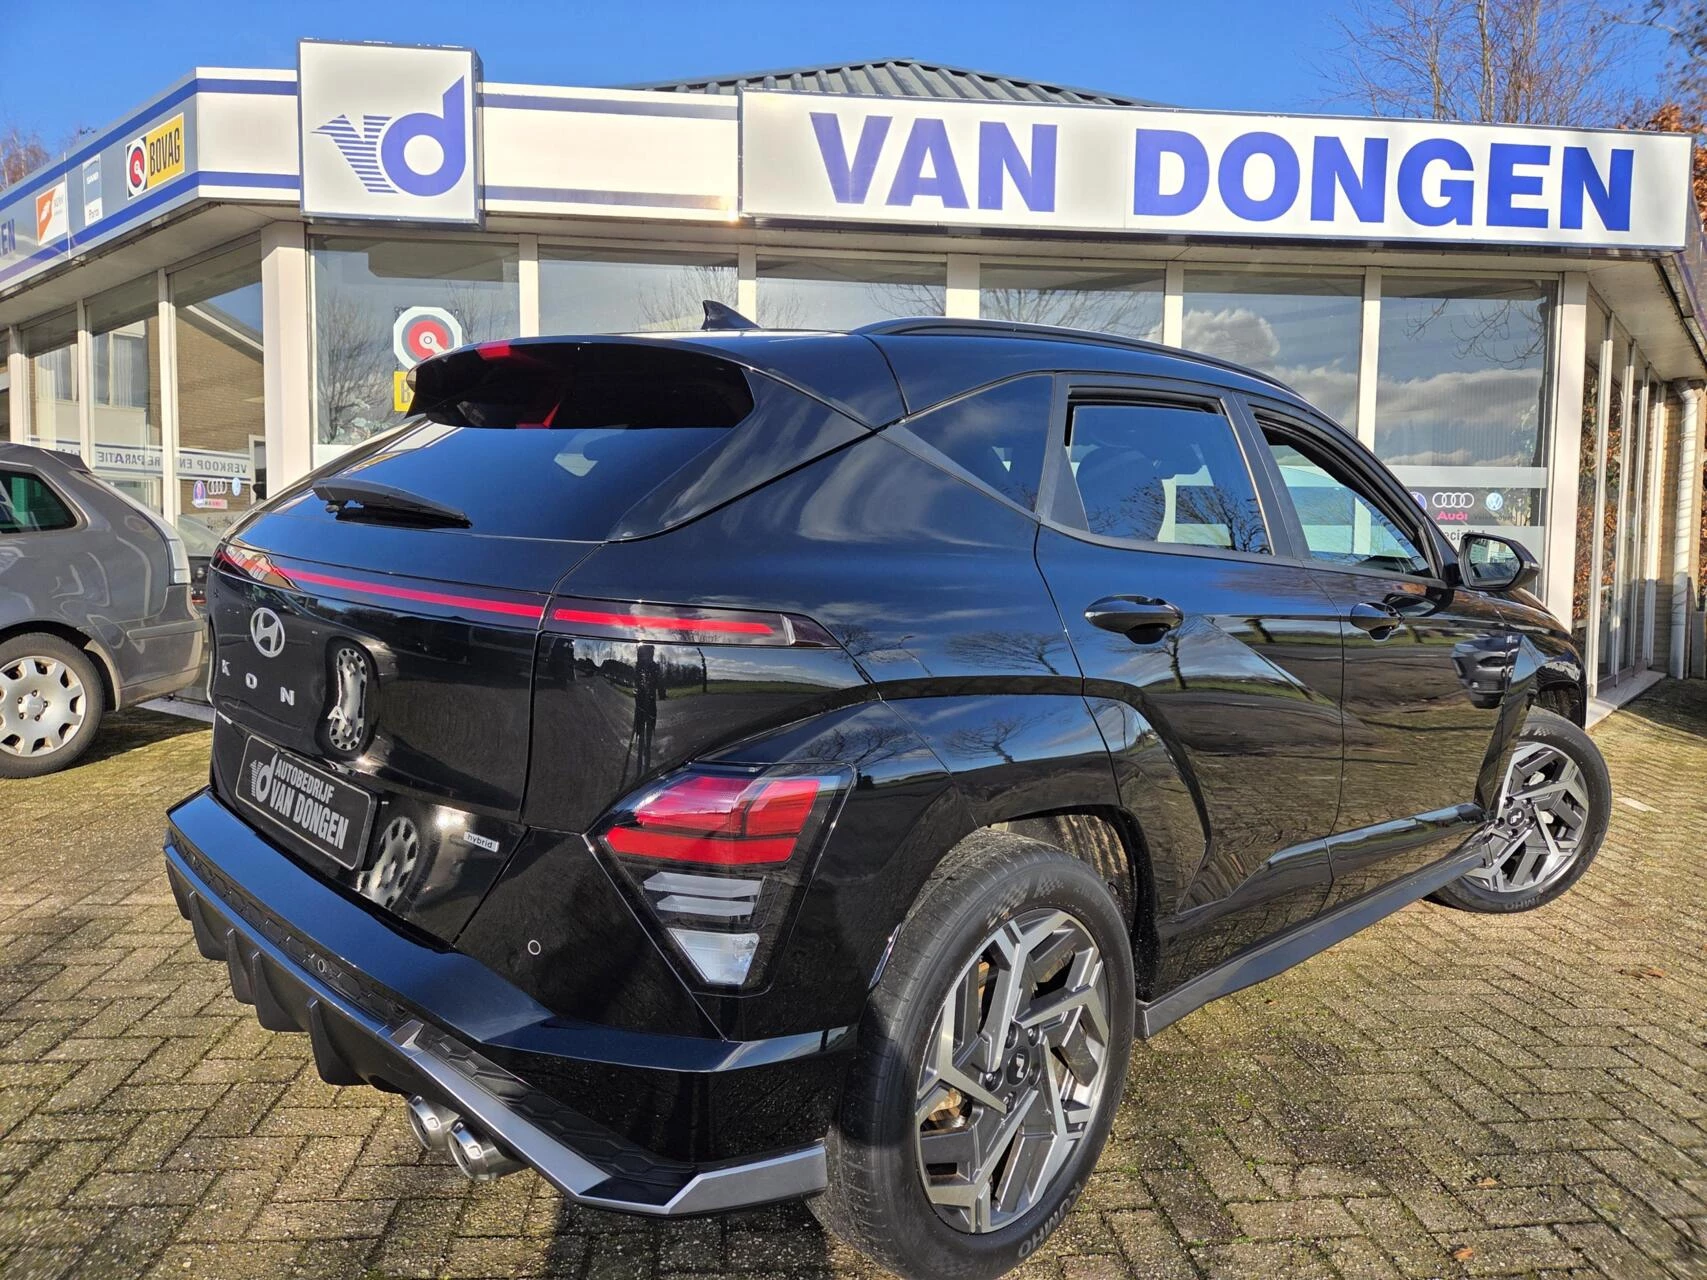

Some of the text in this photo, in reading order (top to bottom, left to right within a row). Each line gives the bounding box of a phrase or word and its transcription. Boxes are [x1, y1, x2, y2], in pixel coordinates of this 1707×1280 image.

[149, 127, 181, 177] BOVAG
[809, 111, 1634, 232] VAN DONGEN
[1436, 510, 1468, 521] Audi
[275, 759, 335, 804] AUTOBEDRIJF
[270, 778, 349, 850] VAN DONGEN
[467, 832, 493, 849] hybrid
[1018, 1181, 1082, 1258] KUMHO
